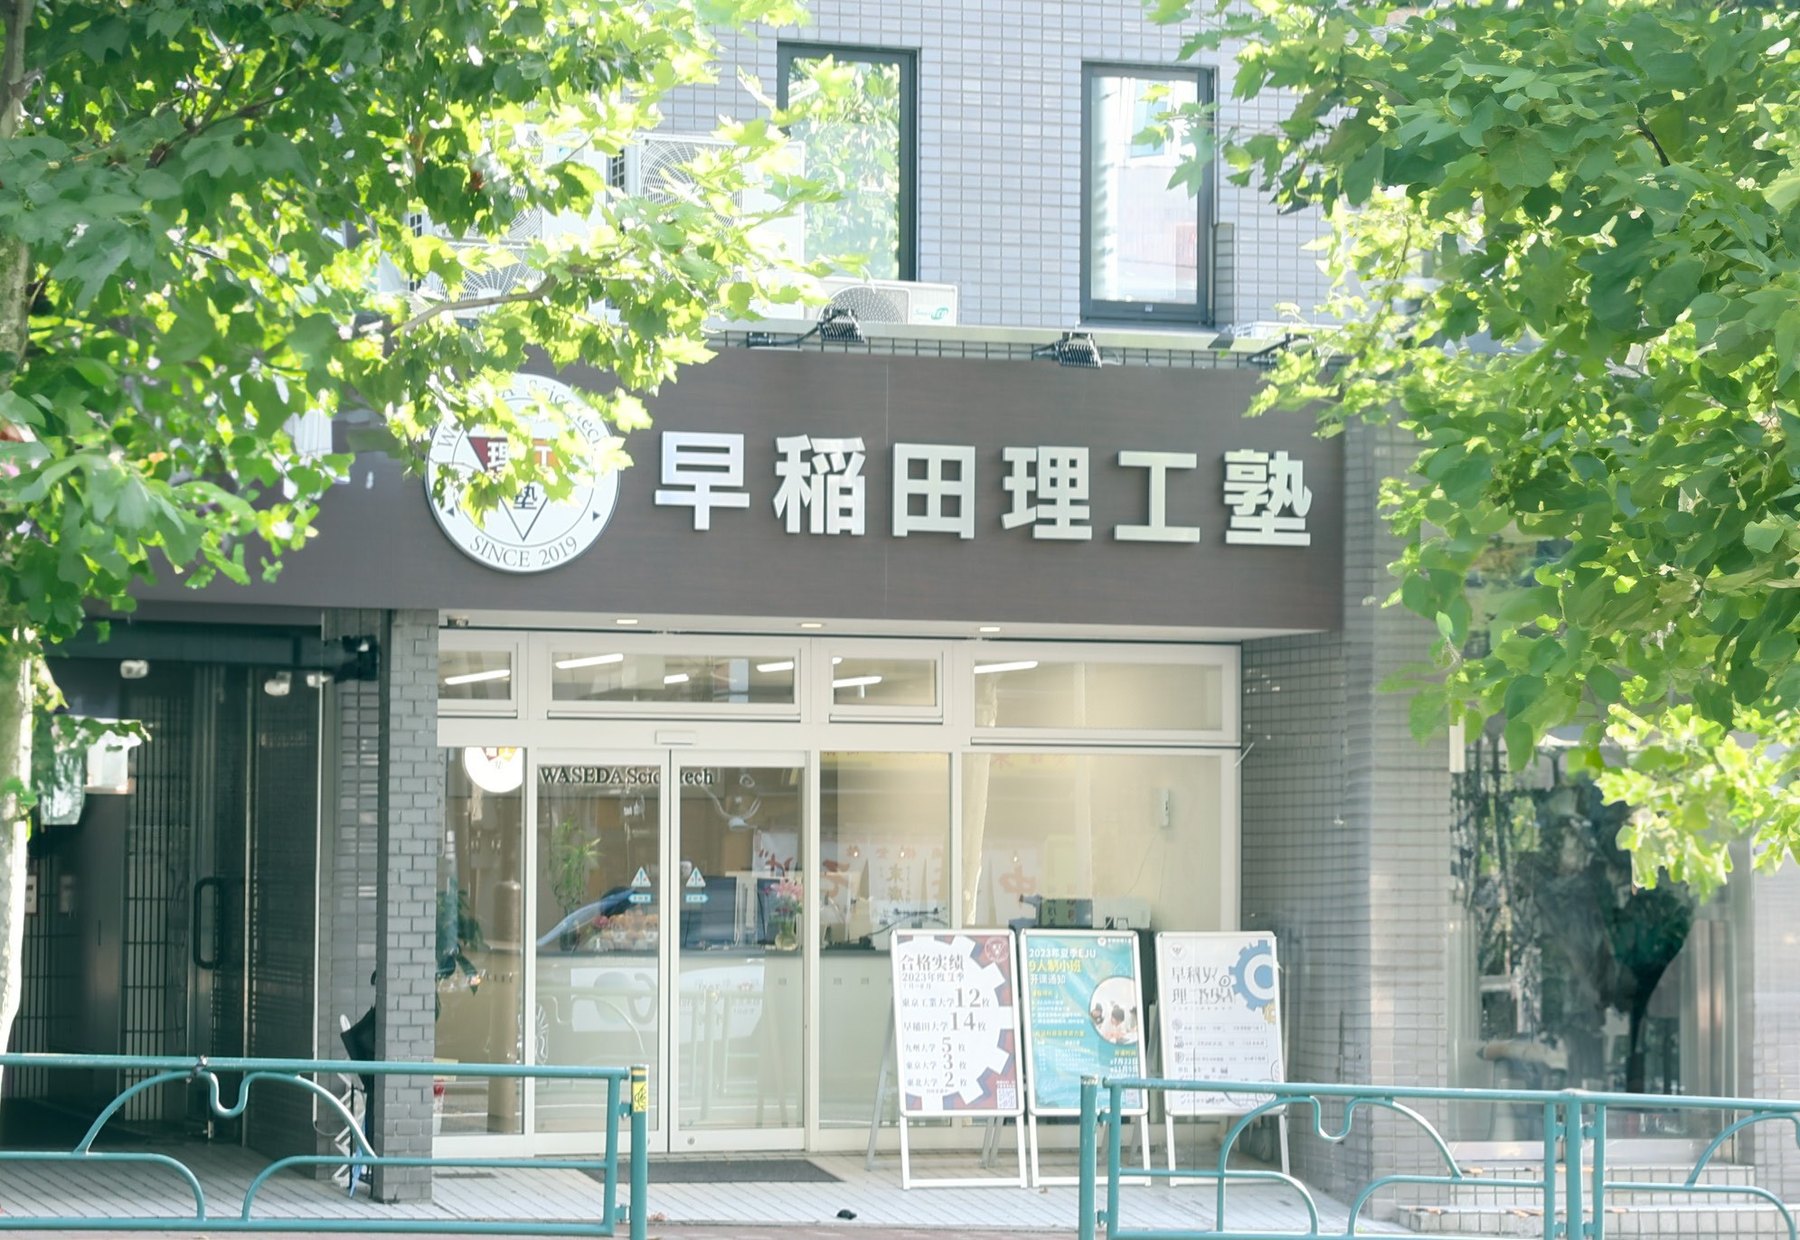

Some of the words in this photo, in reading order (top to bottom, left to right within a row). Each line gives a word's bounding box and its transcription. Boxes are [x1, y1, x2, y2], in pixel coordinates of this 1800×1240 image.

[654, 430, 1312, 546] 早稲田理工塾
[469, 535, 530, 568] SINCE
[538, 535, 577, 566] 2019
[540, 766, 623, 785] WASEDA
[941, 1036, 952, 1053] 5
[943, 1053, 953, 1070] 3
[944, 1071, 955, 1088] 2
